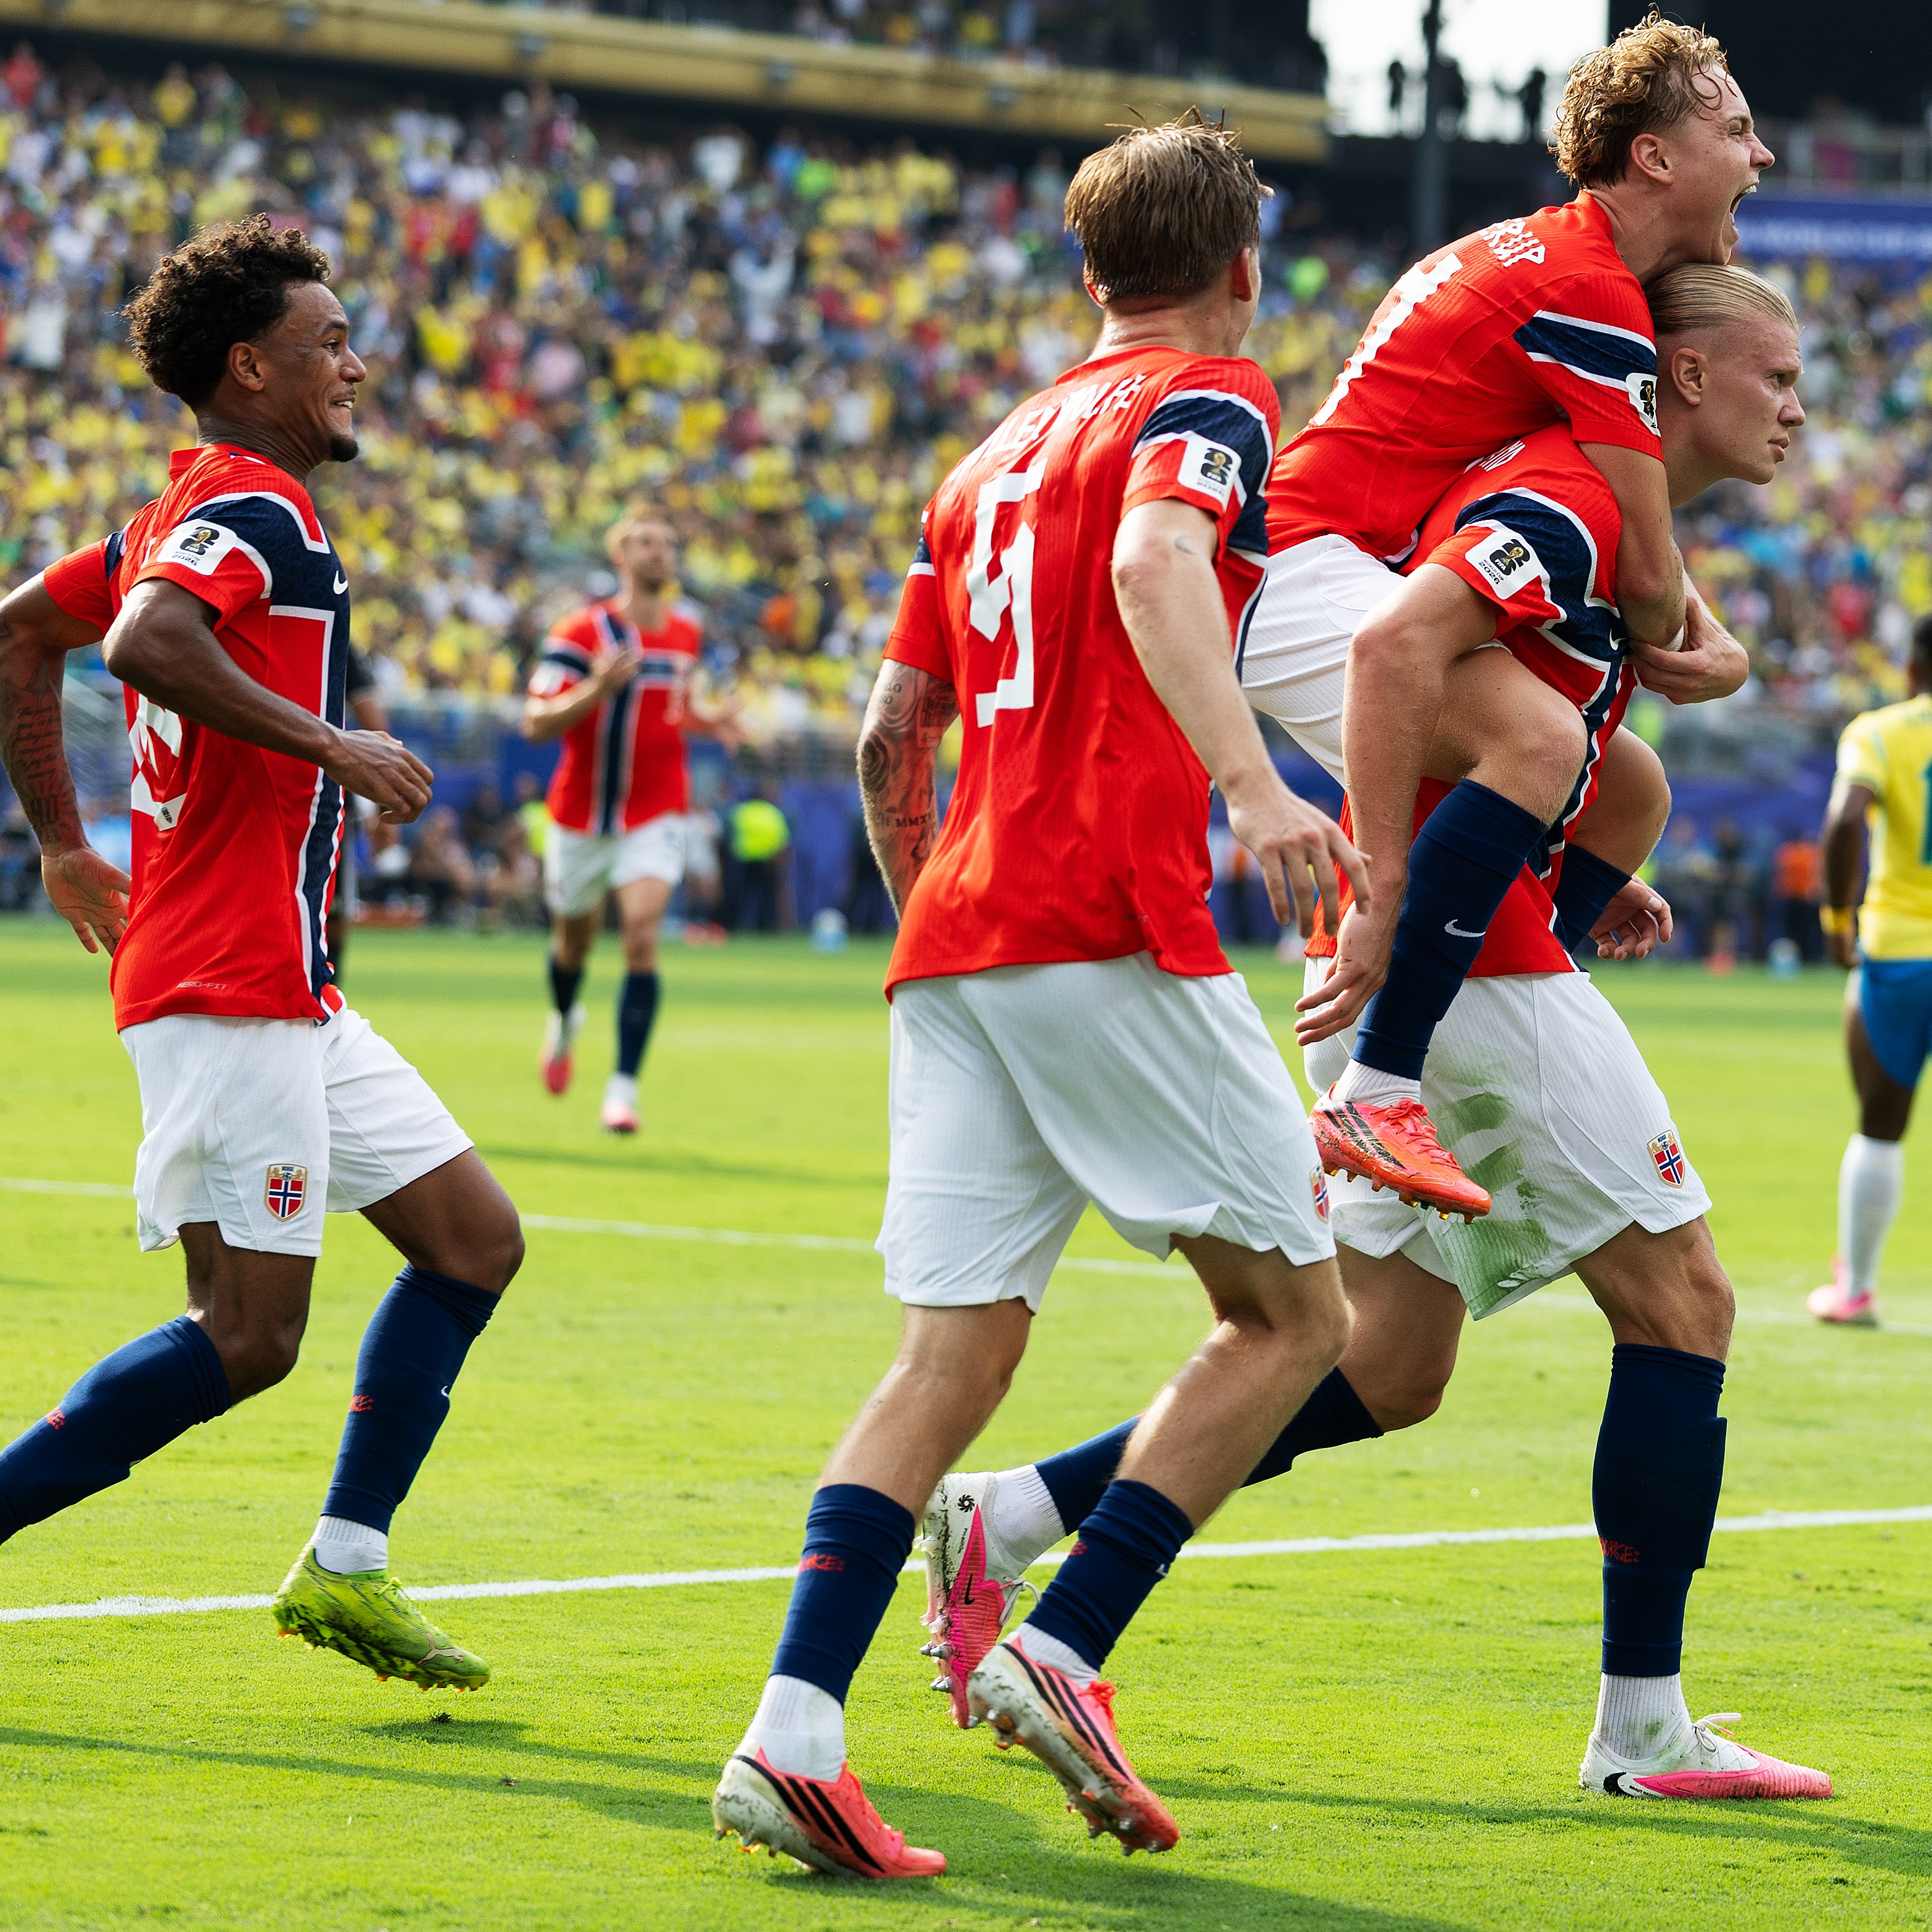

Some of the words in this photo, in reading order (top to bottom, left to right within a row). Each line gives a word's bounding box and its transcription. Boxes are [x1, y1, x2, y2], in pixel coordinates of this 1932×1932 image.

[1478, 561, 1500, 585] 2026
[1483, 559, 1497, 573] WORLD
[1496, 571, 1505, 581] CUP
[1495, 558, 1506, 571] FIFA
[966, 458, 1048, 728] 5
